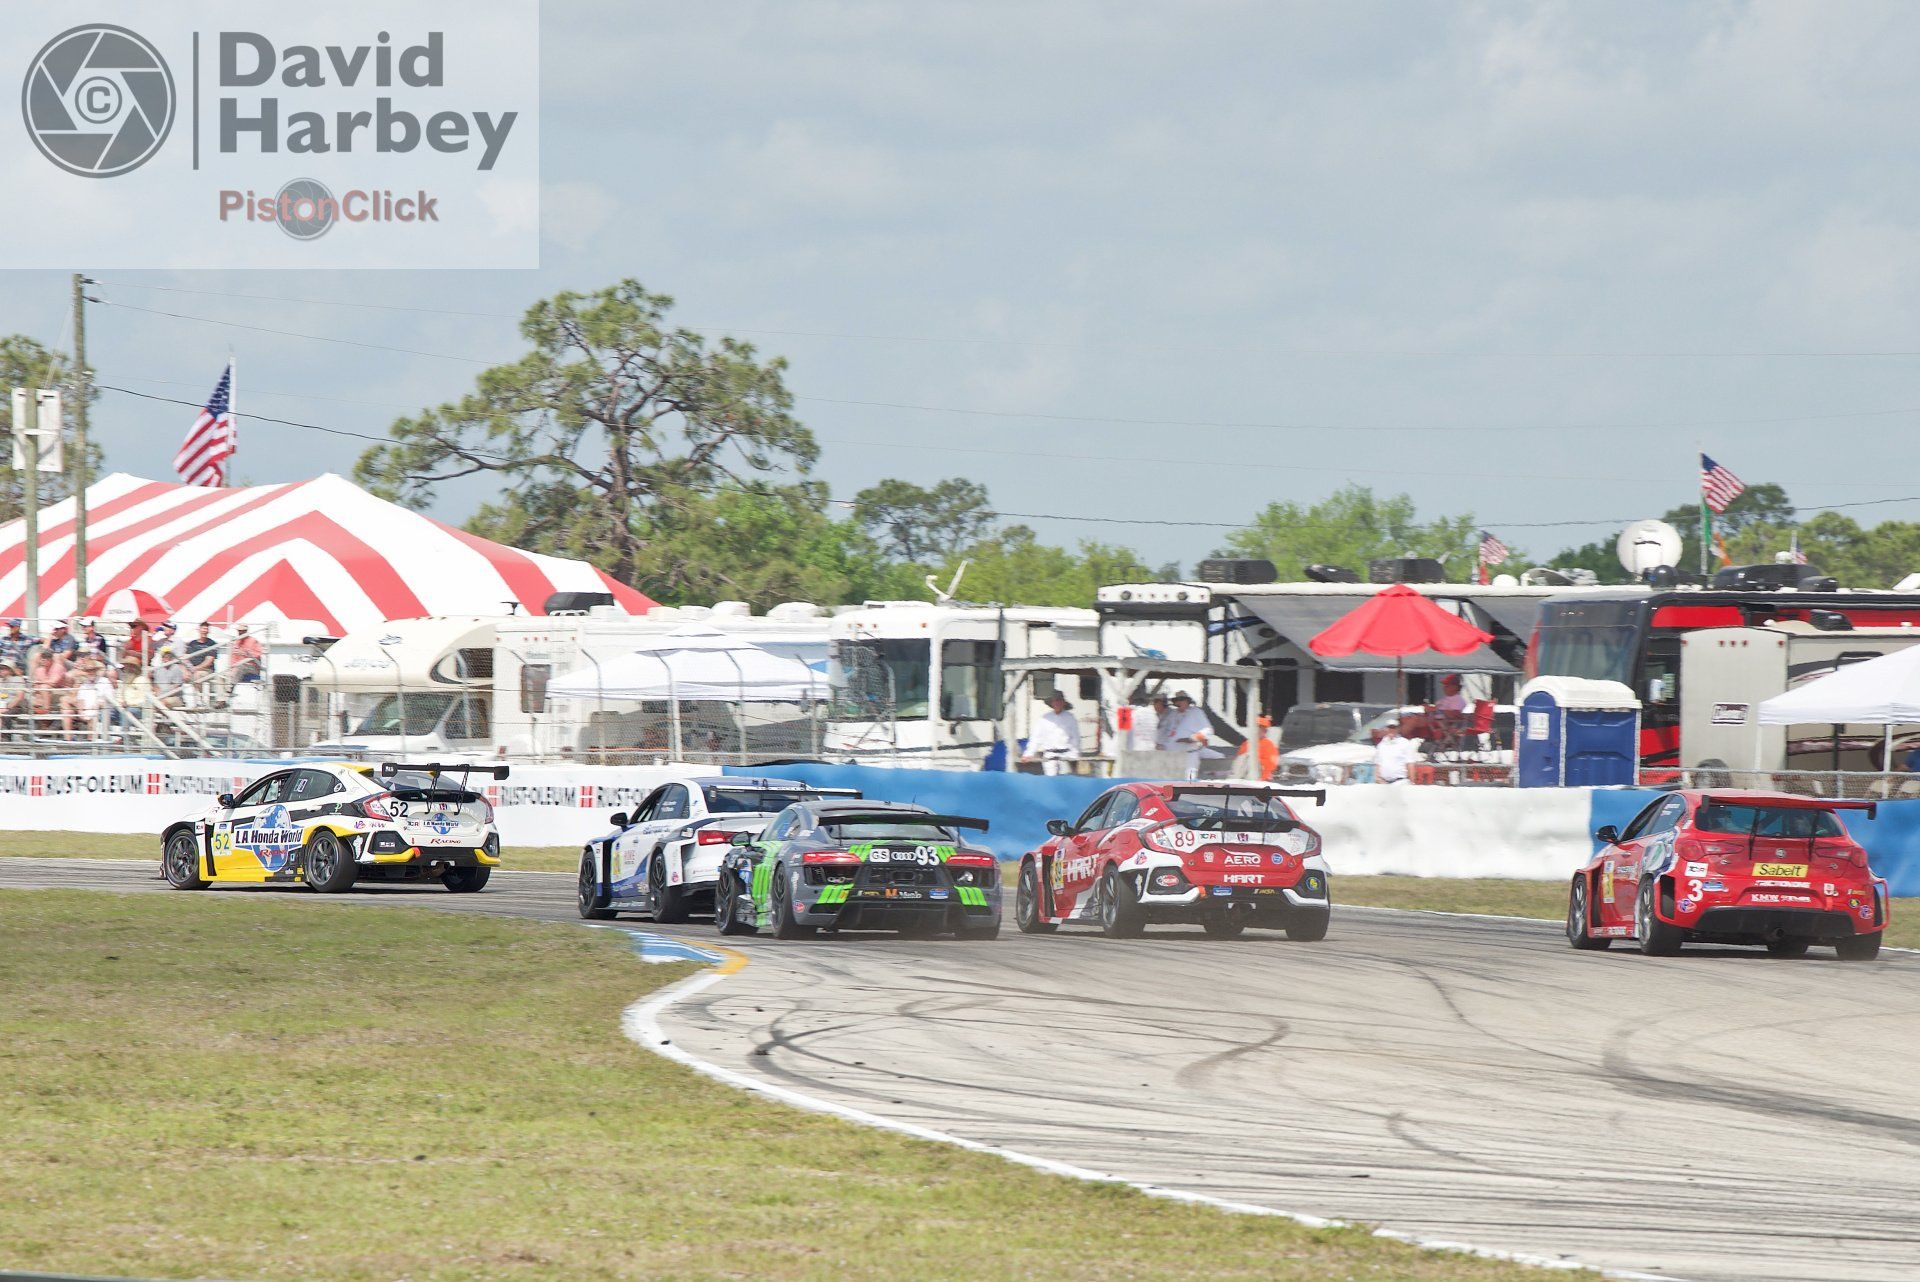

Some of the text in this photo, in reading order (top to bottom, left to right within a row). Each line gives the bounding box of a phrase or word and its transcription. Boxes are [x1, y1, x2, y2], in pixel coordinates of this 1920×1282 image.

[390, 801, 409, 817] 52
[215, 833, 230, 850] 52
[235, 829, 303, 844] LA Honda World
[1175, 830, 1195, 848] 89
[872, 851, 887, 859] GS
[915, 846, 940, 865] 93
[1224, 855, 1261, 865] AERO
[1066, 853, 1099, 882] HART
[1759, 863, 1803, 877] Sabelt
[1223, 875, 1265, 884] HART
[1687, 879, 1704, 902] 3
